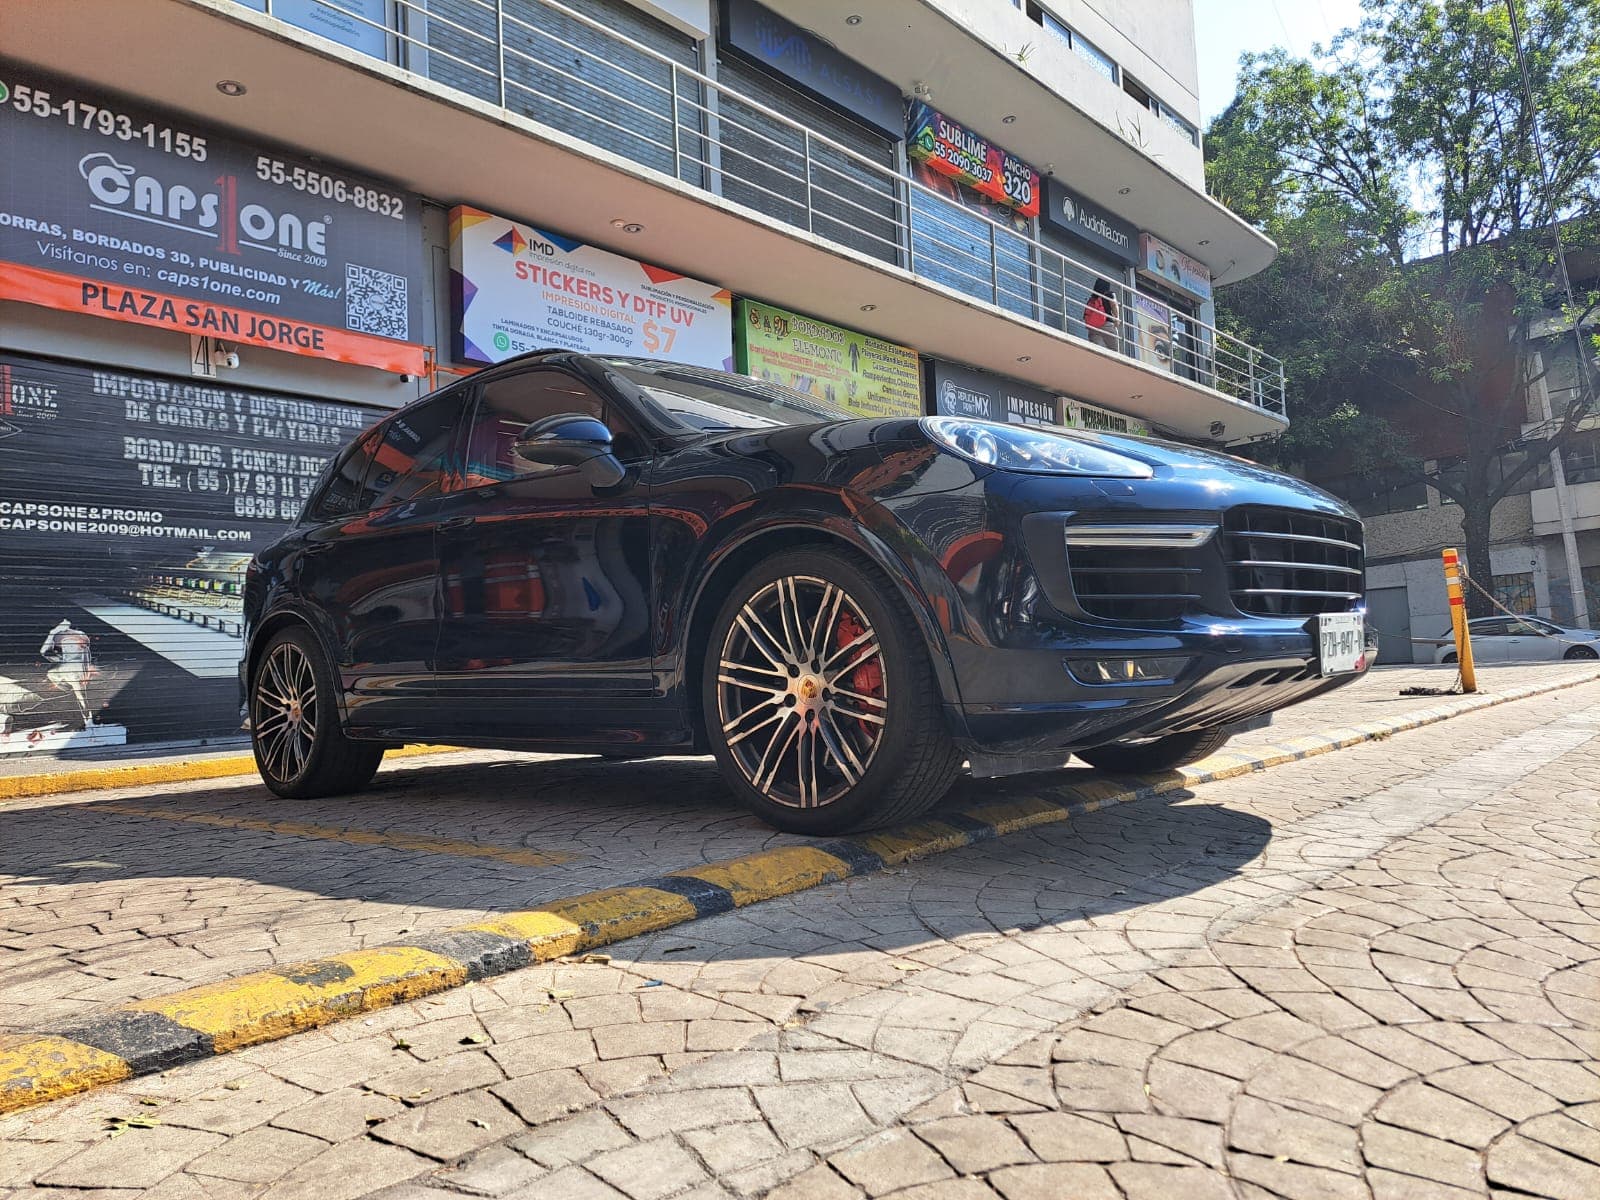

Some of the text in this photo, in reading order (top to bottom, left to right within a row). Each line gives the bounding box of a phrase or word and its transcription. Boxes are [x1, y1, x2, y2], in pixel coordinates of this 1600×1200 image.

[12, 85, 207, 162] 55-1793-1155
[939, 120, 988, 163] SUBLIME
[1003, 157, 1031, 180] ANCHO
[256, 156, 404, 220] 55-5506-8832
[1003, 171, 1031, 204] 320
[72, 229, 166, 259] BORDADOS
[170, 251, 195, 268] 3D,
[199, 257, 287, 287] PUBLICIDAD
[290, 278, 300, 289] Y
[302, 279, 342, 299] Más!
[304, 255, 328, 268] 2009
[529, 239, 554, 256] IMD
[37, 240, 281, 305] Visítanos en: caps1one.com
[515, 260, 695, 328] STICKERS Y DTF UV
[81, 282, 325, 351] PLAZA SAN JORGE
[547, 305, 634, 335] TABLOIDE REBASADO
[600, 306, 636, 324] DIGITAL
[791, 316, 845, 345] BORDADOS
[584, 327, 634, 348] 130gr-300gr
[642, 318, 677, 353] $7
[194, 335, 212, 376] 4
[92, 371, 363, 428] IMPORTACION Y DISTRIBUCION
[974, 395, 989, 417] MX
[125, 400, 341, 446] DE GORRAS Y PLAYERAS
[138, 462, 181, 488] TEL:
[233, 472, 250, 493] 17
[255, 474, 276, 496] 93
[281, 476, 295, 498] 11
[0, 502, 163, 523] CAPSONE&PROMO
[0, 518, 252, 541] CAPSONE2009@HOTMAIL.COM
